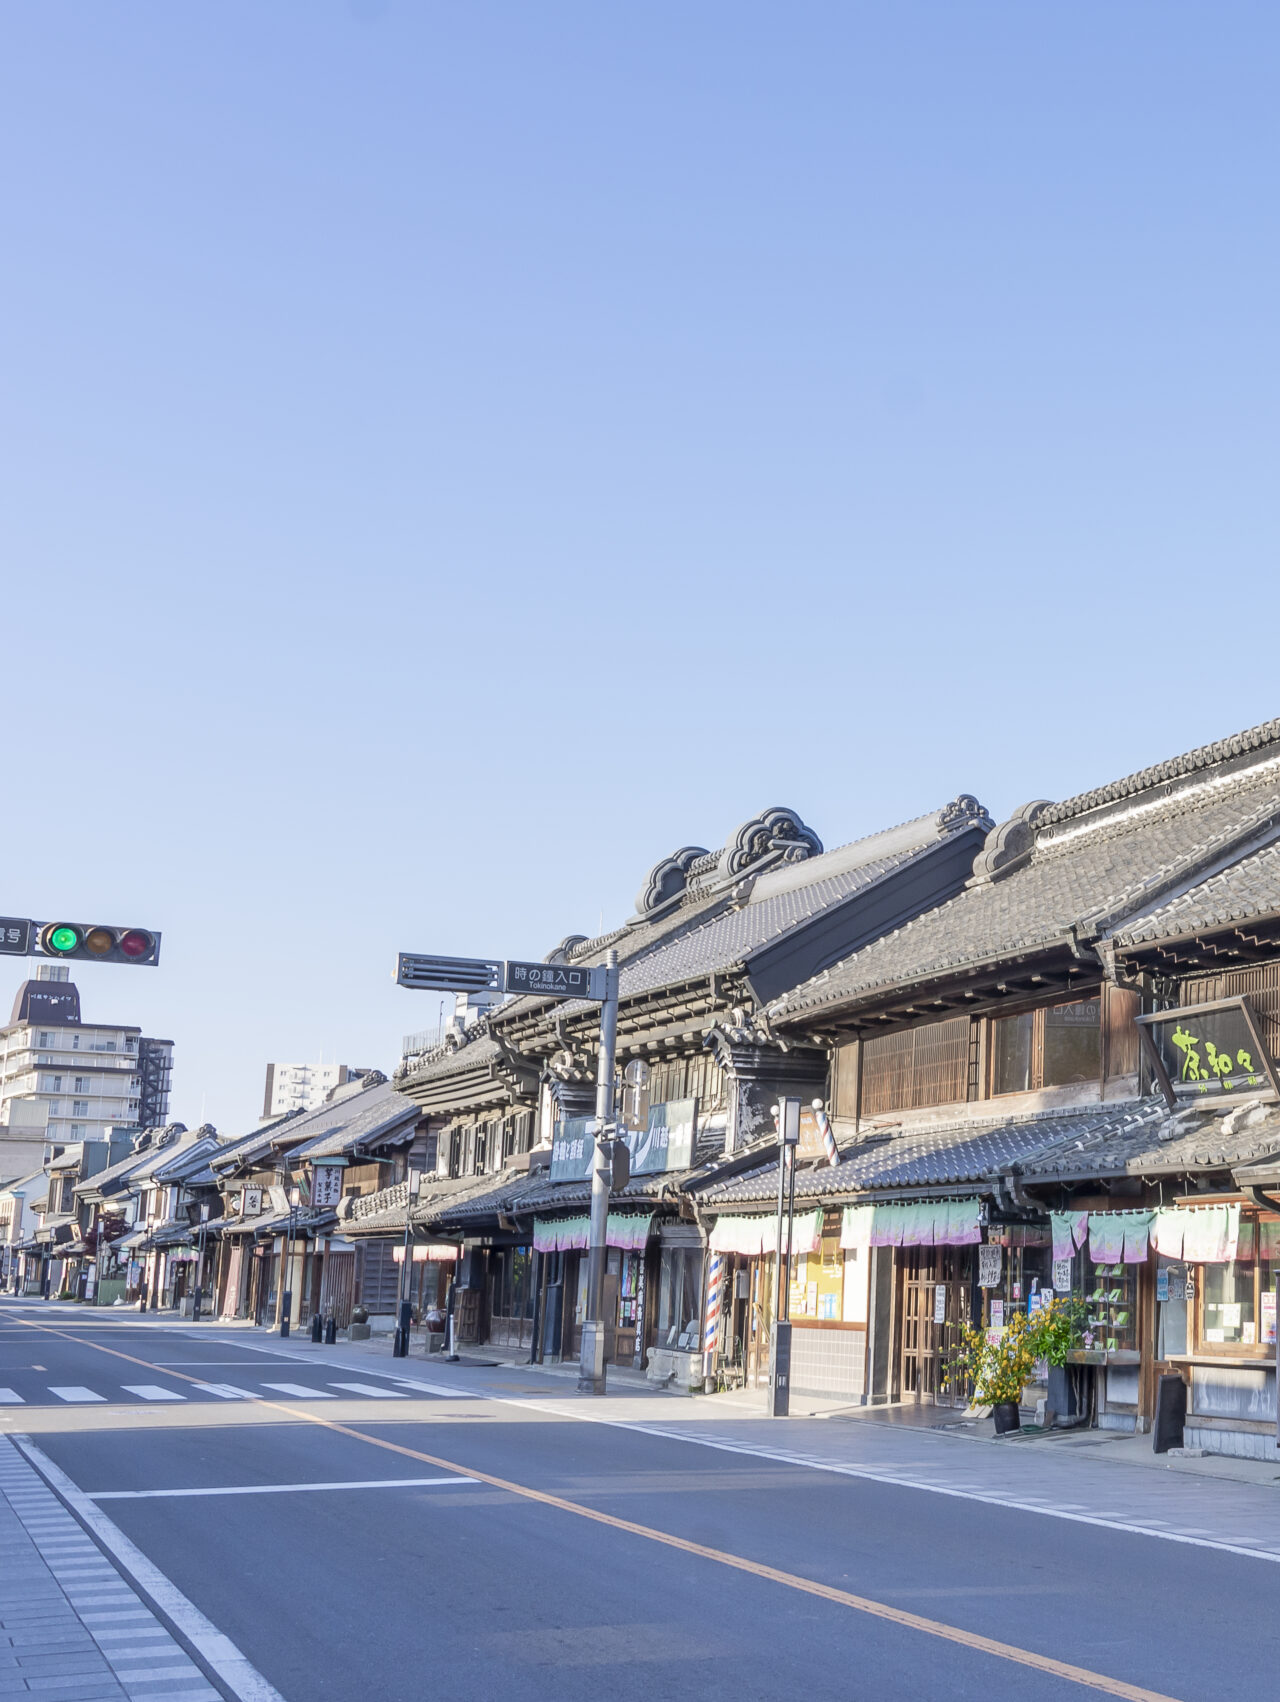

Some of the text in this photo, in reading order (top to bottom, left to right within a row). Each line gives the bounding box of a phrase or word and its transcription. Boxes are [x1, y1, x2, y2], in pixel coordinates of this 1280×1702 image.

[514, 966, 581, 985] 時の鐘入口
[529, 981, 566, 991] Tokinokane
[324, 1167, 334, 1204] 芋菓子
